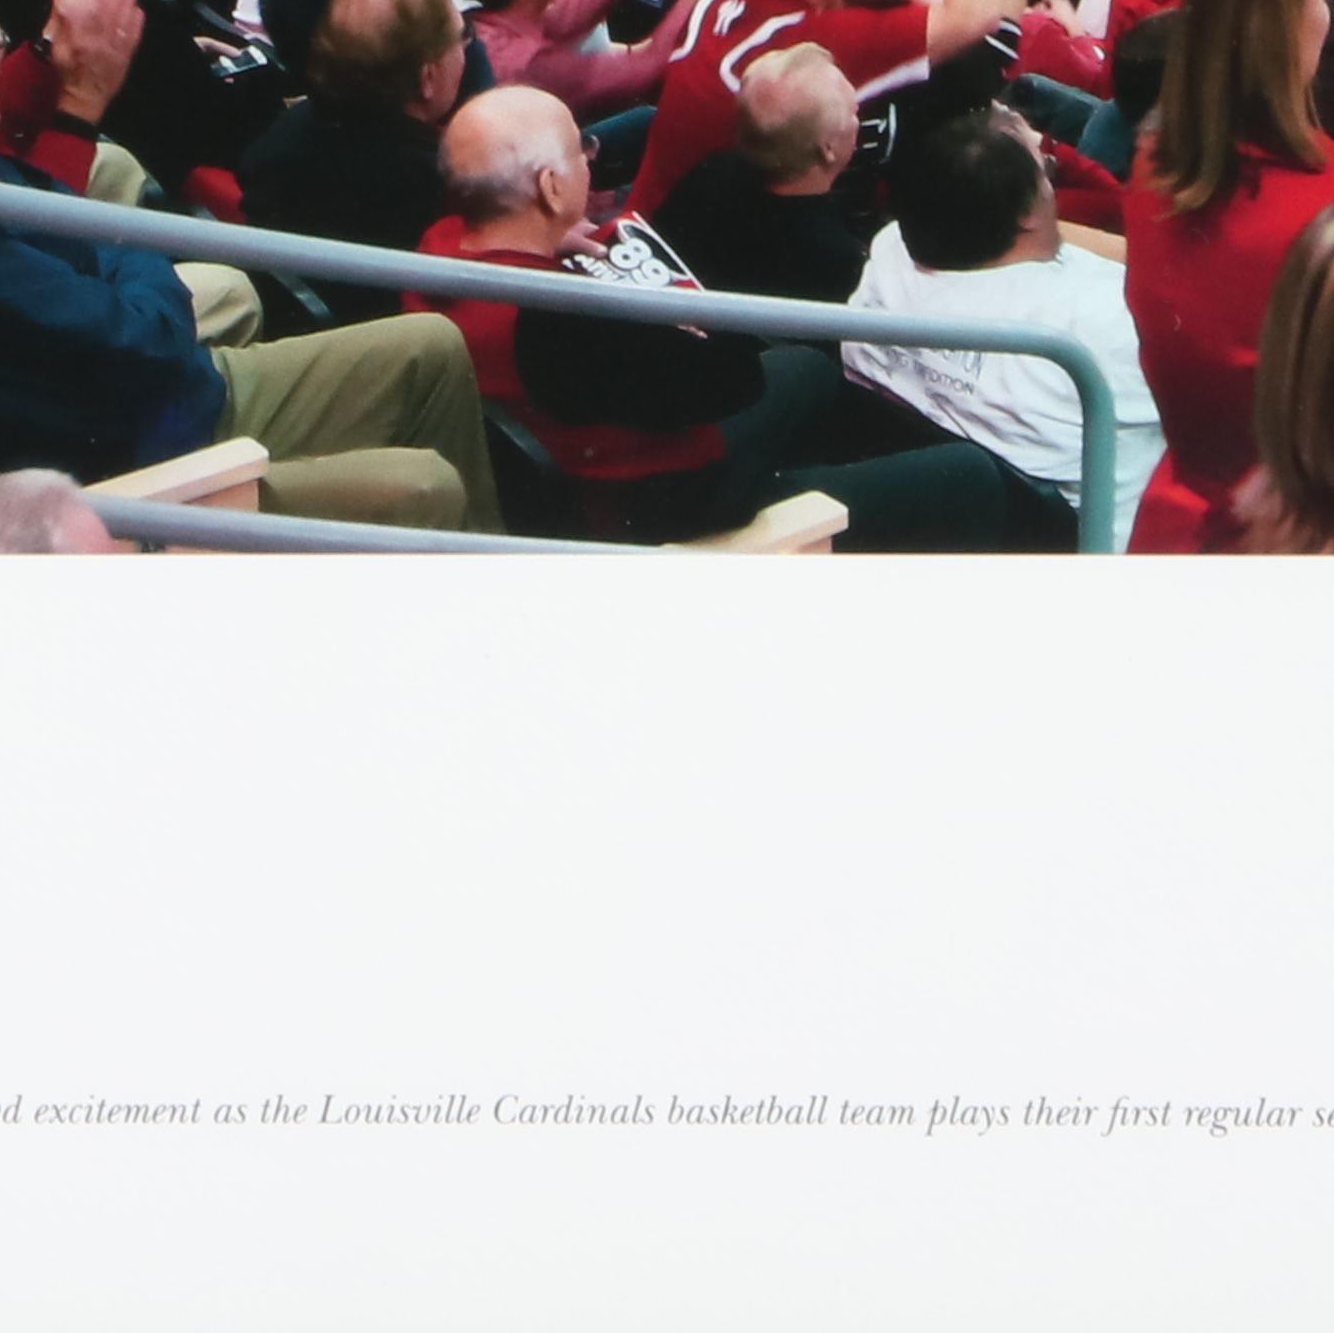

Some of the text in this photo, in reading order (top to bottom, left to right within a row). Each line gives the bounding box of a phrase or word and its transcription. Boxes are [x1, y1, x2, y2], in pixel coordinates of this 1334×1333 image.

[33, 1095, 201, 1124] excitement
[213, 1104, 247, 1124] as
[260, 1094, 308, 1124] the
[319, 1093, 481, 1125] Louisville
[493, 1094, 655, 1125] Cardinals
[667, 1094, 829, 1125] basketball
[839, 1099, 915, 1126] team
[925, 1095, 1010, 1137] plays
[1023, 1095, 1100, 1127] their
[1104, 1095, 1171, 1137] first
[1185, 1096, 1304, 1137] regular
